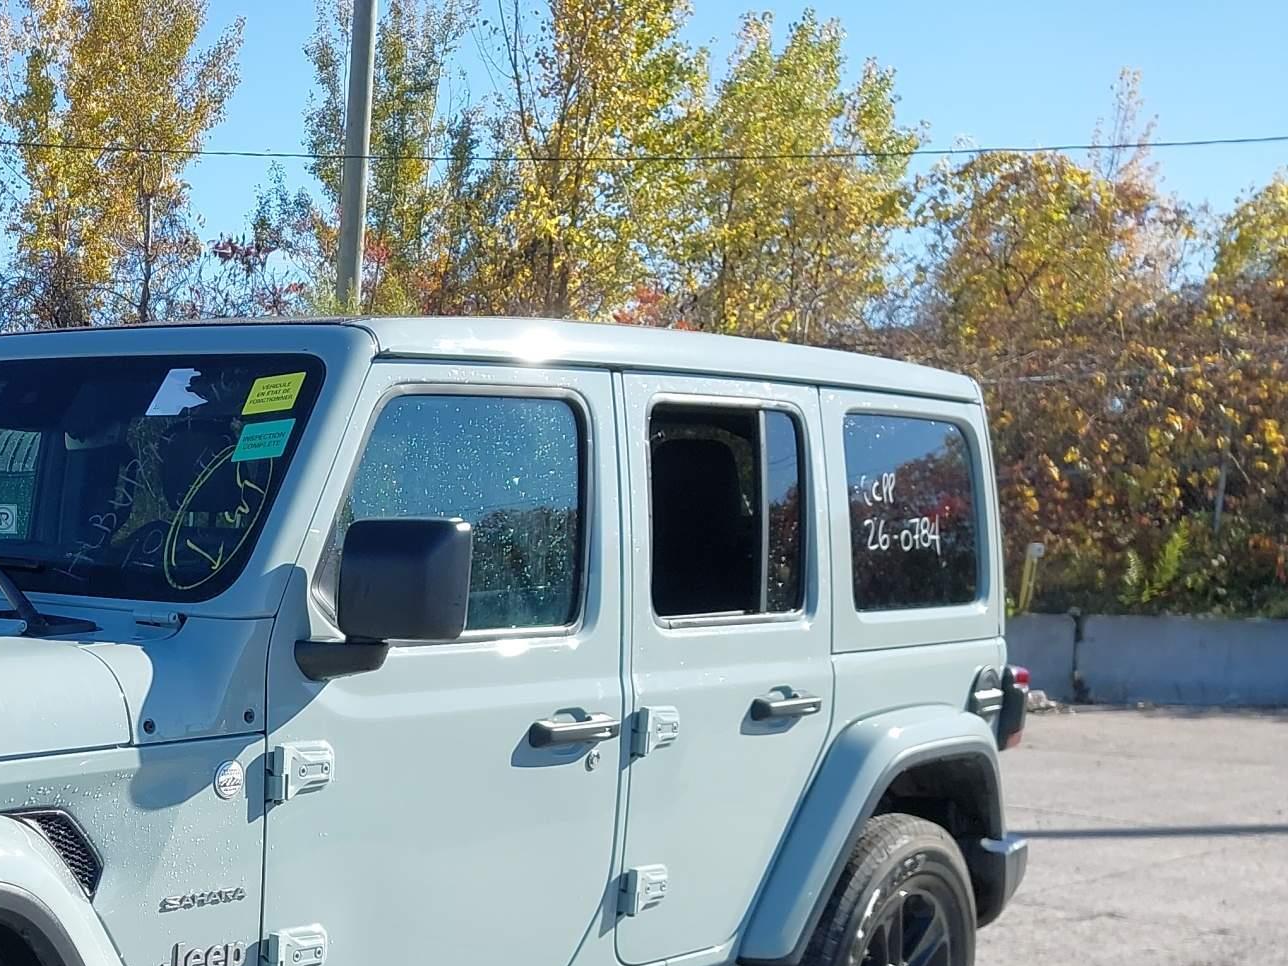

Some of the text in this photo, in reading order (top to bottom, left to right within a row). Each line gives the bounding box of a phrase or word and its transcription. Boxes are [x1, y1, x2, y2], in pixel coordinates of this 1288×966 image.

[242, 431, 287, 442] INSPECTION
[863, 513, 941, 556] 26-0784
[158, 887, 247, 914] SAHARA
